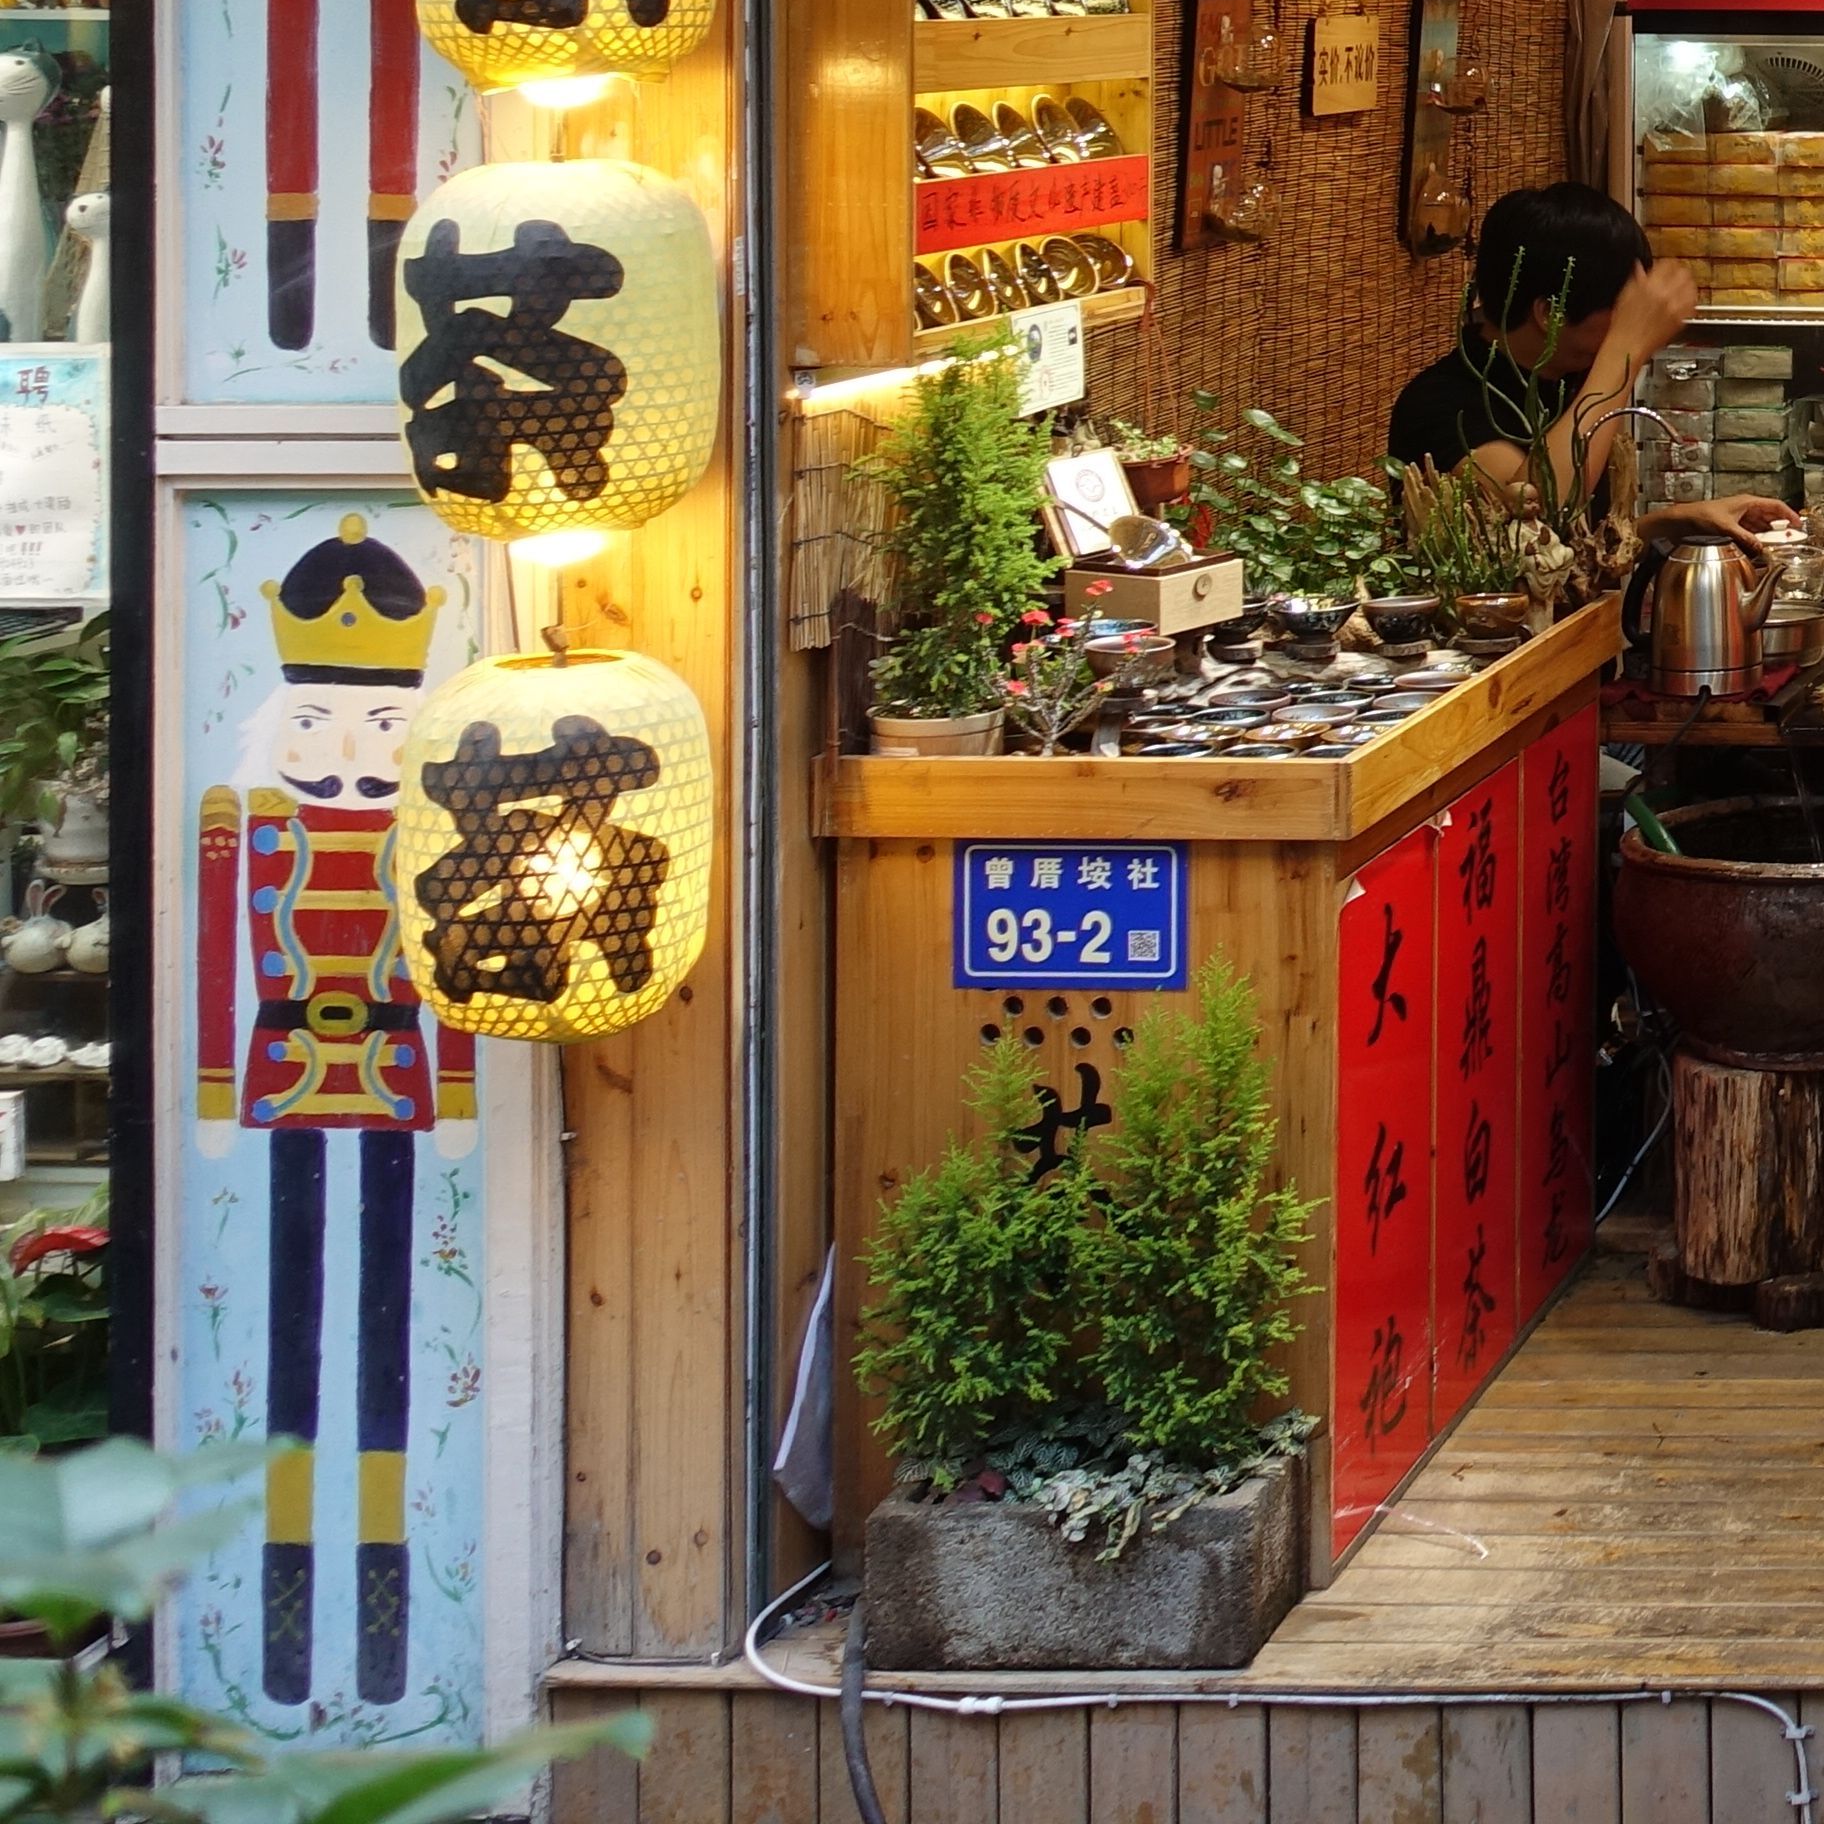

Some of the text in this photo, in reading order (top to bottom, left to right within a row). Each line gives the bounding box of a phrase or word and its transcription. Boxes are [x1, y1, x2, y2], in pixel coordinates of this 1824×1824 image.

[16, 365, 51, 404] 聘
[399, 218, 629, 503] 茶
[415, 716, 671, 1005] 茶
[984, 856, 1160, 892] 曾厝垵社
[986, 908, 1114, 965] 93-2
[1358, 902, 1408, 1459] 大红袍
